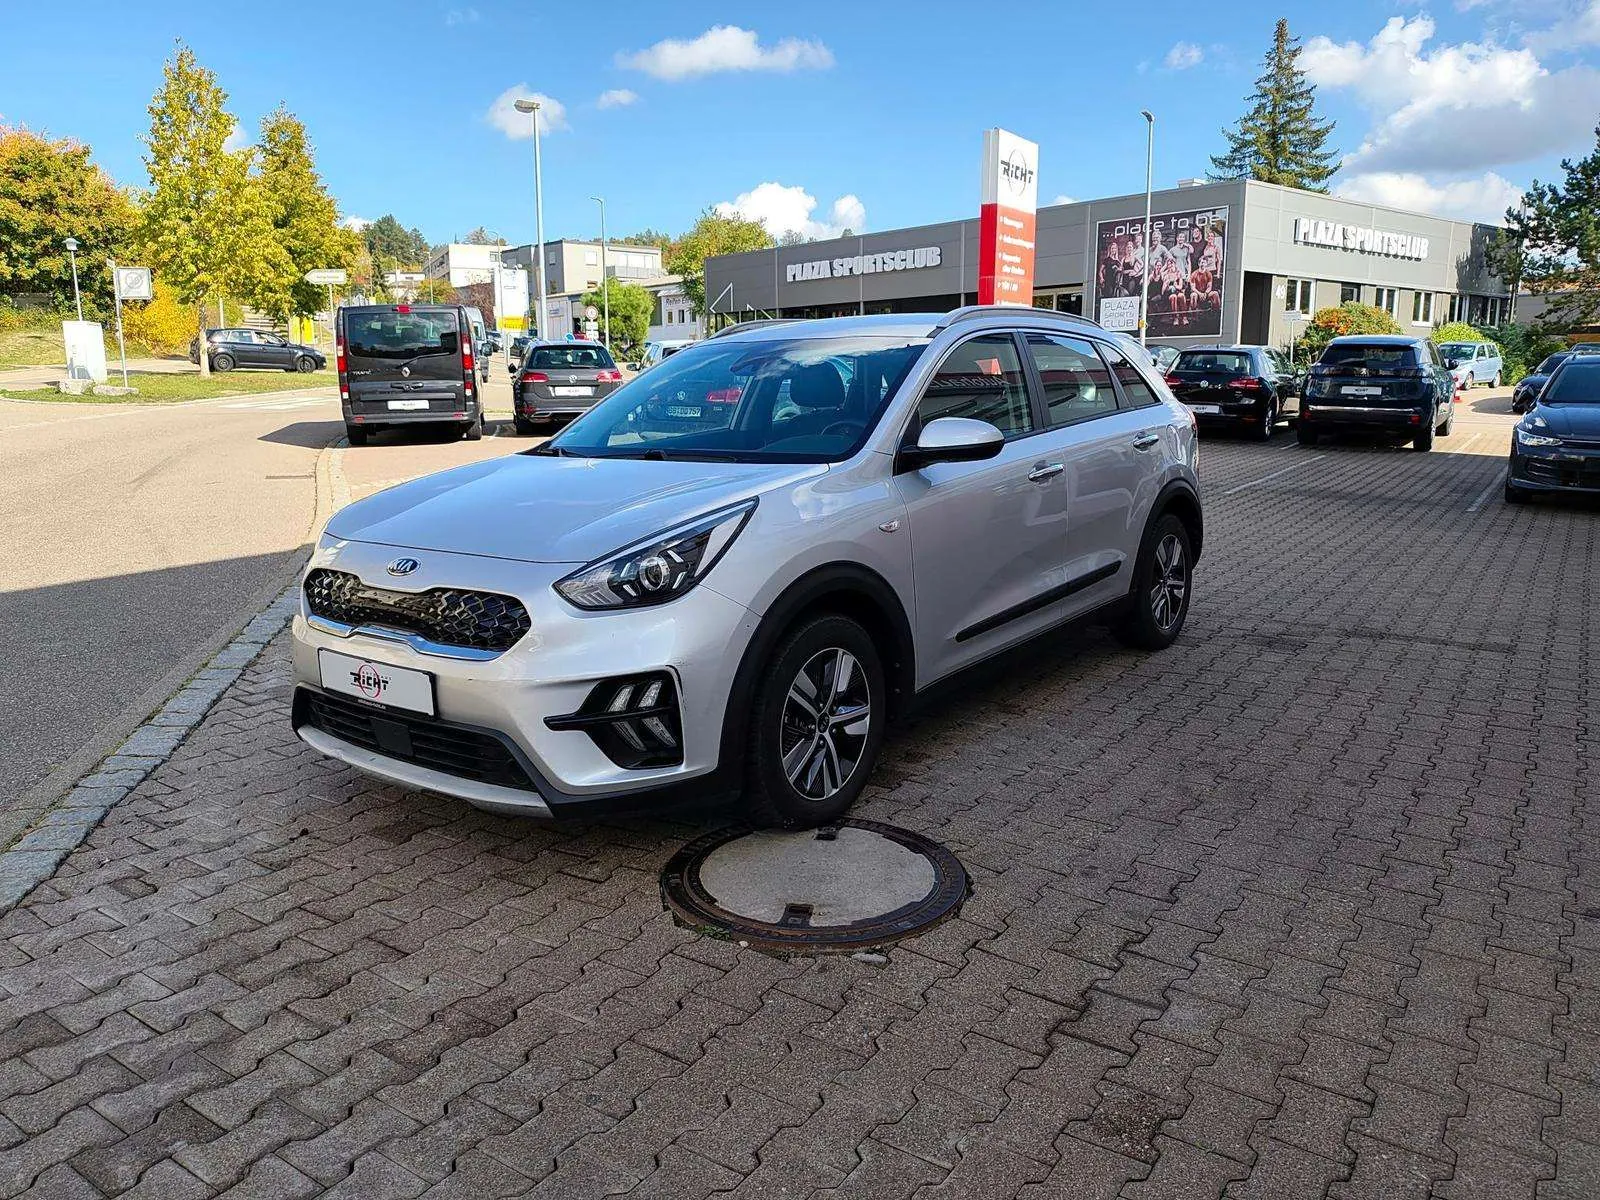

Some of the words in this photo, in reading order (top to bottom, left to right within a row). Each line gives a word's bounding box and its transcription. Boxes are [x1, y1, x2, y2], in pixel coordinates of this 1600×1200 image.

[1171, 216, 1189, 230] to
[1196, 213, 1220, 227] be
[1297, 217, 1344, 248] PLAZA
[1344, 225, 1430, 260] SPORTSCLUB
[787, 260, 832, 282] PLAZA
[832, 246, 941, 277] SPORTSCLUB
[1104, 300, 1136, 311] PLAZA
[1103, 318, 1135, 328] CLUB
